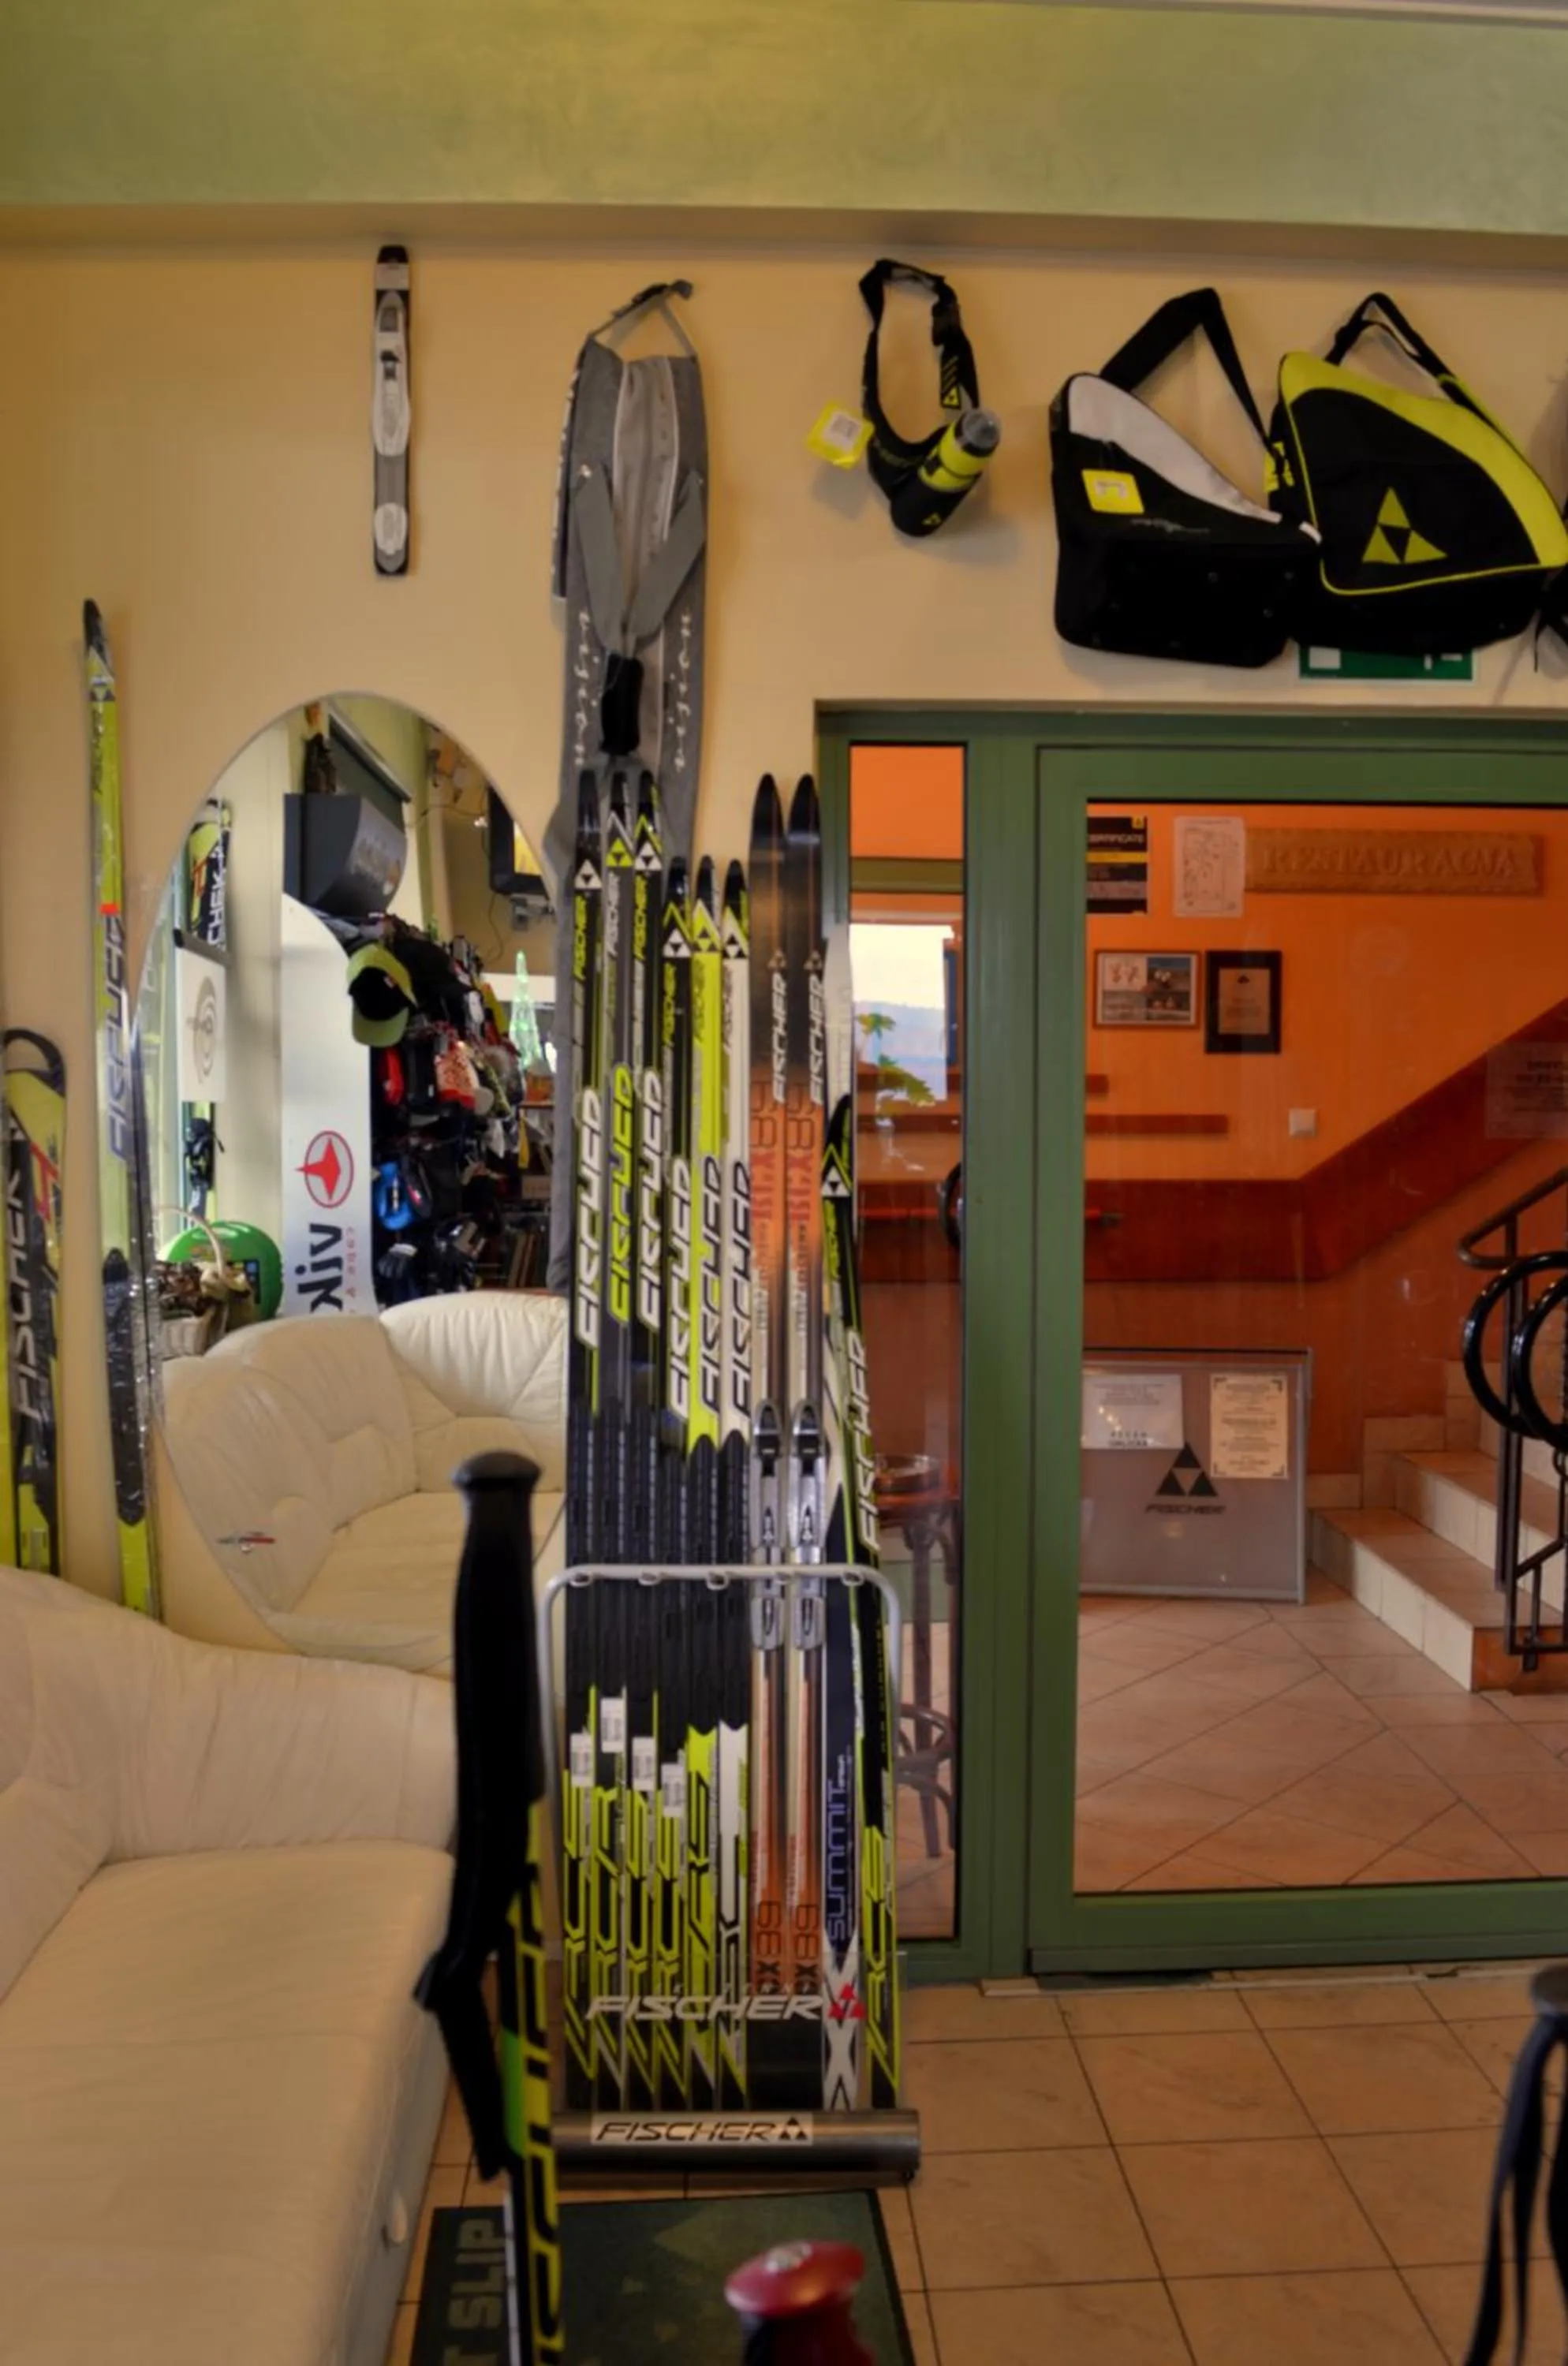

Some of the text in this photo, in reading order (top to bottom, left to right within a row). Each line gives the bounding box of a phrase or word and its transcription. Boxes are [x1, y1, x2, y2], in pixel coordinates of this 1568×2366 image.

[772, 972, 787, 1103] FISCHER
[808, 972, 825, 1104] FISCHER
[1145, 1504, 1226, 1515] FISCHER
[827, 1779, 846, 1940] SUMMIT
[585, 1995, 823, 2021] FISCHER
[595, 2121, 775, 2141] FISCHER
[449, 2219, 506, 2329] SLIP
